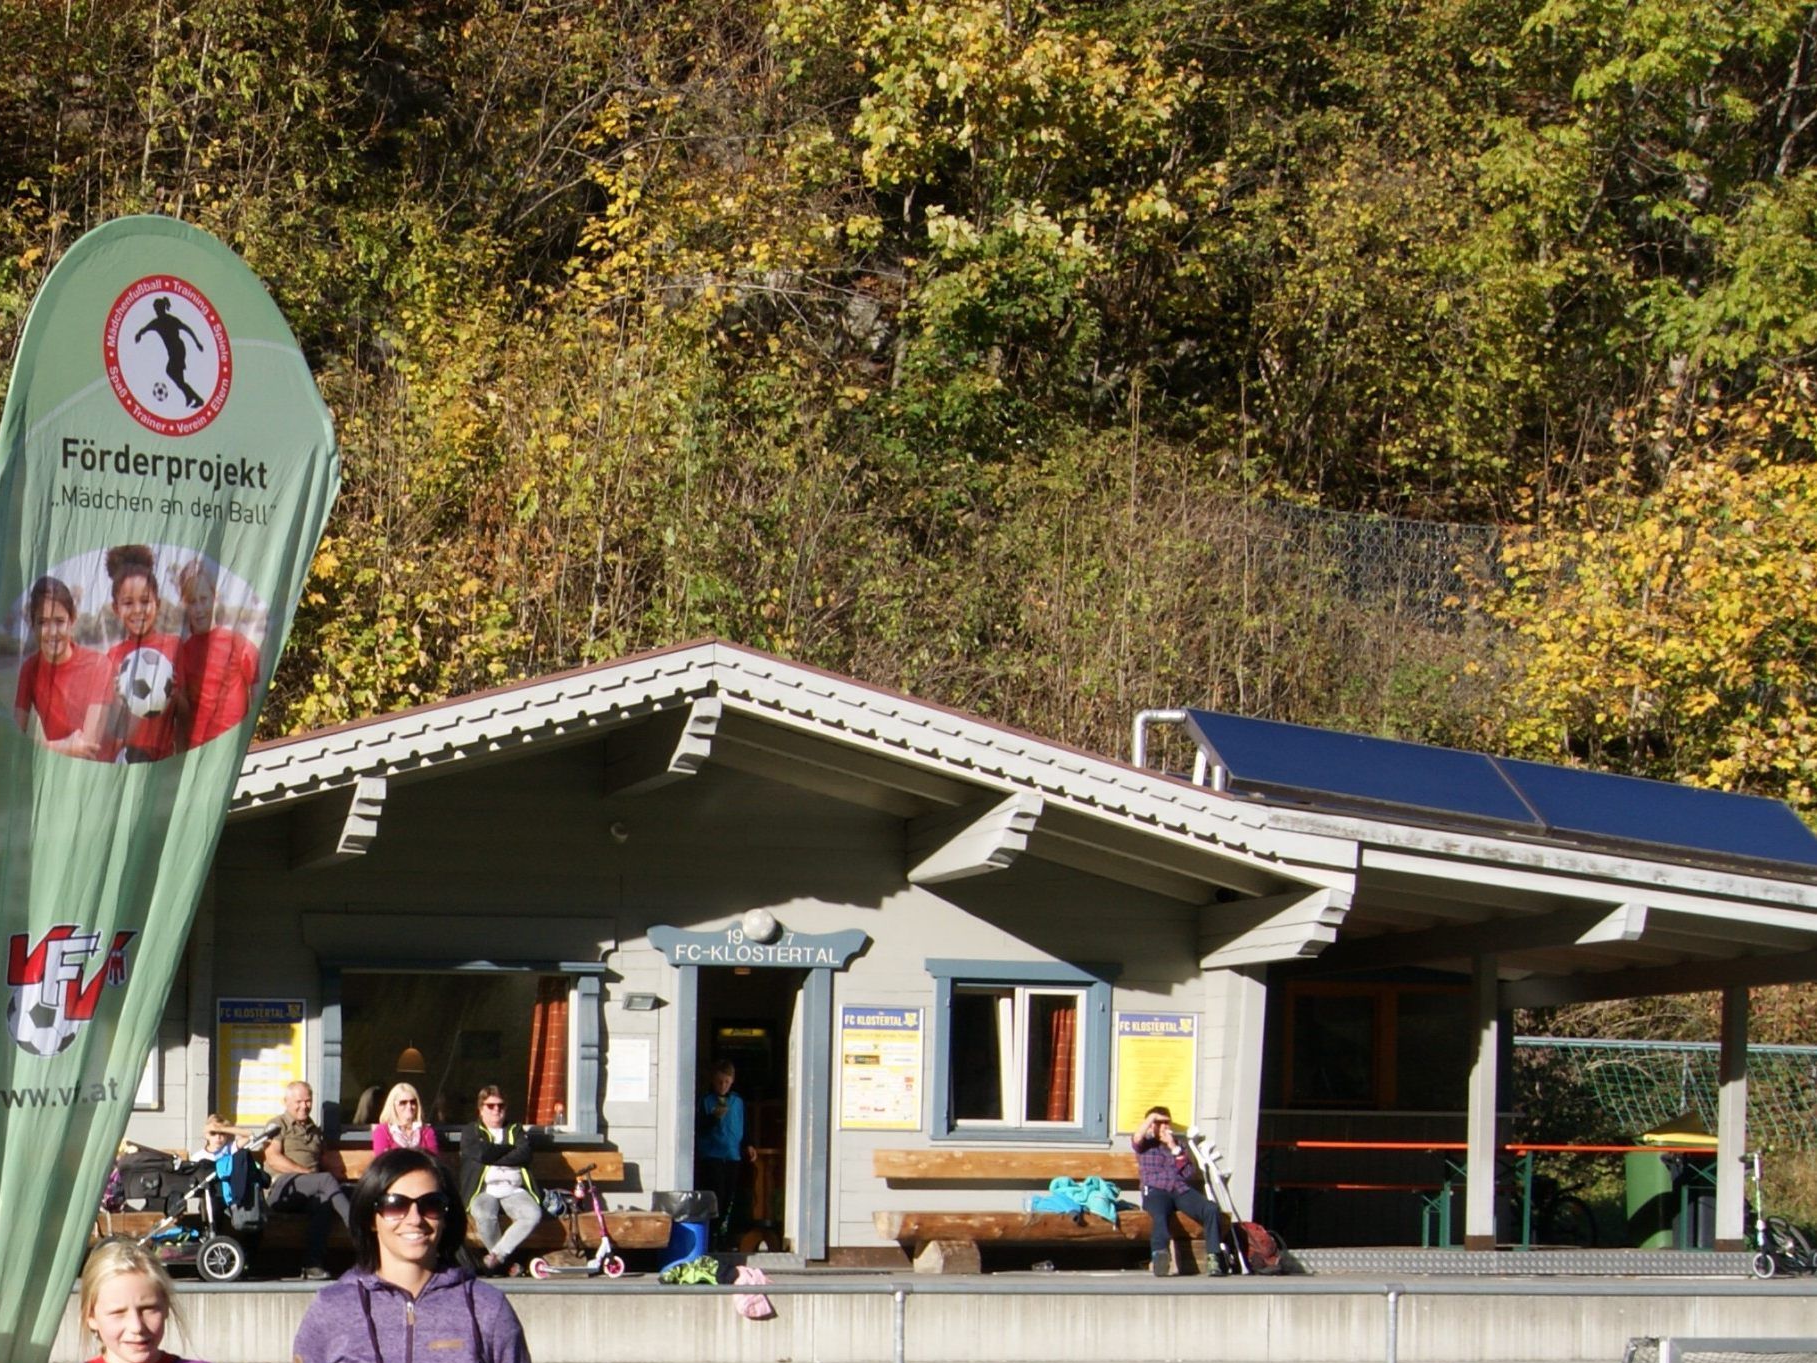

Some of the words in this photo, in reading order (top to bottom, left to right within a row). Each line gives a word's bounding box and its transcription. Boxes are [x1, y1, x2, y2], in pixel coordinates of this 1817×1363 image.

[172, 280, 210, 317] Training
[107, 279, 162, 348] Mädchenfußball
[212, 323, 229, 363] Spiele
[109, 366, 128, 399] Spaß
[210, 378, 229, 412] Eltern
[133, 405, 167, 431] Trainer
[176, 416, 208, 433] Verein
[61, 437, 268, 491] Förderprojekt
[160, 499, 184, 515] an
[190, 497, 223, 520] den
[675, 942, 841, 965] FC-KLOSTERTAL
[844, 1014, 856, 1025] FC
[857, 1015, 903, 1027] KLOSTERTAL
[1119, 1021, 1131, 1032] FC
[1132, 1021, 1179, 1033] KLOSTERTAL
